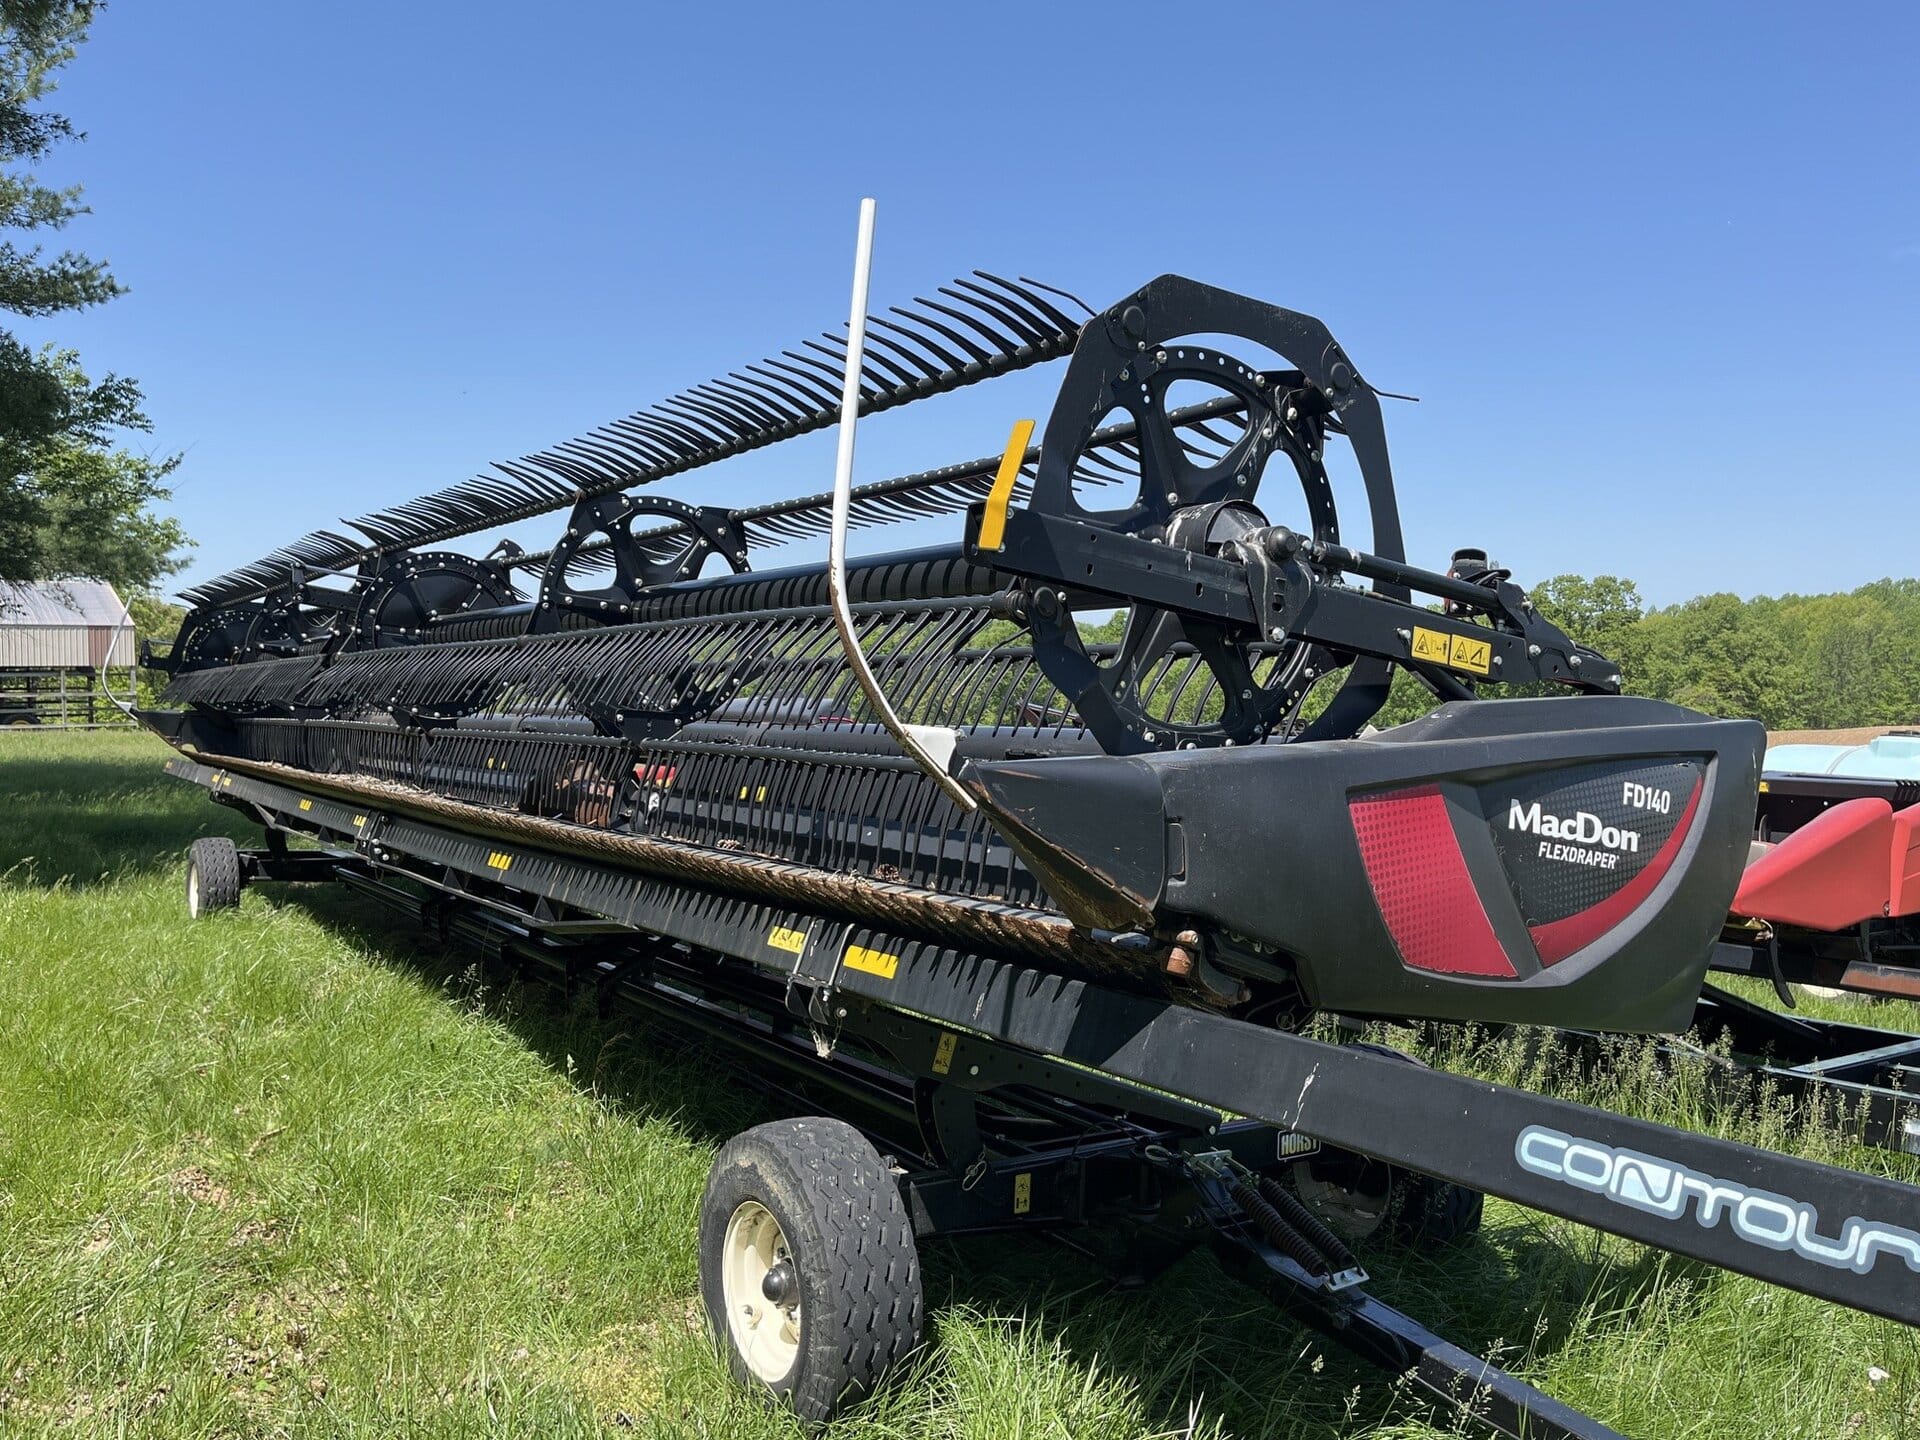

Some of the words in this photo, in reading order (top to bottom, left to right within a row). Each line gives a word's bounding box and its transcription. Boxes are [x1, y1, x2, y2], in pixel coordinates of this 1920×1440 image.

[1622, 781, 1671, 815] FD140
[1508, 798, 1639, 852] MacDon
[1538, 841, 1617, 870] FLEXDRAPER
